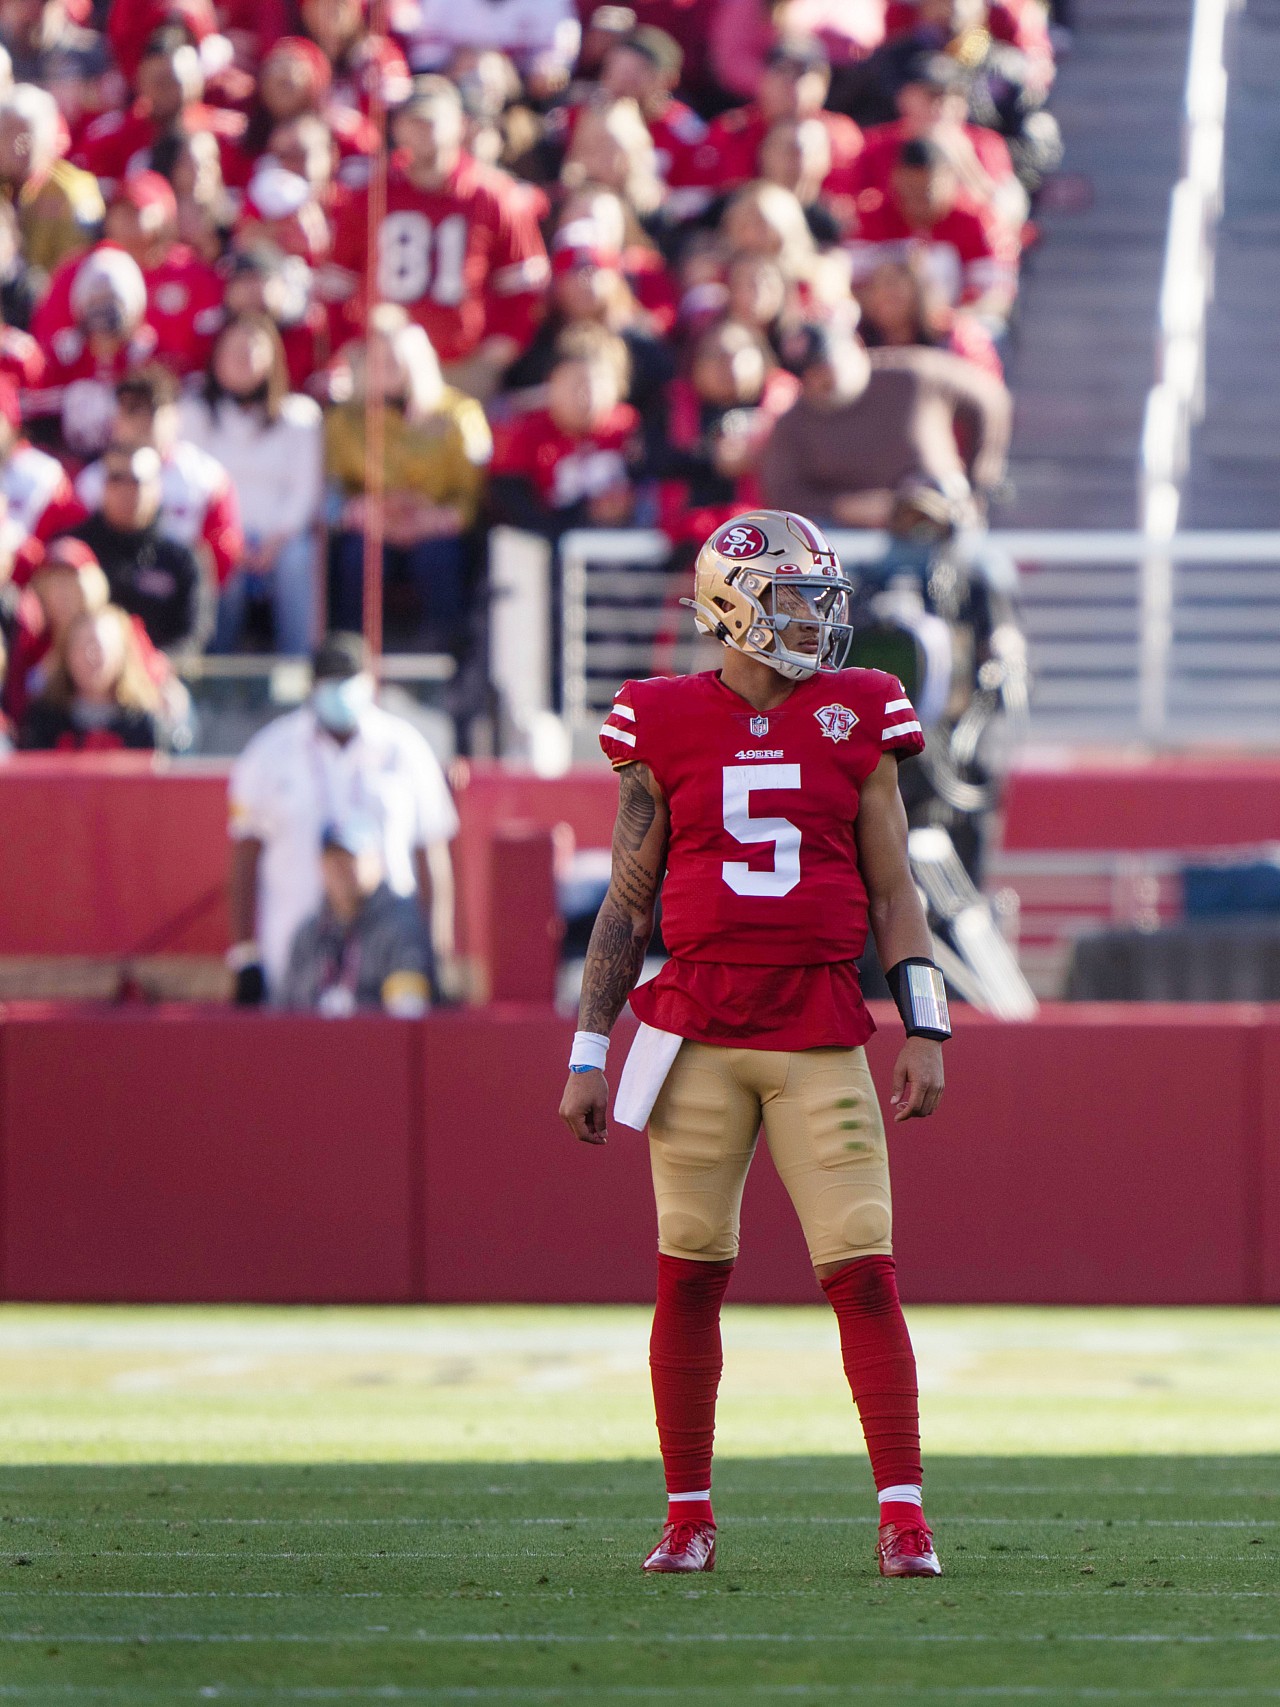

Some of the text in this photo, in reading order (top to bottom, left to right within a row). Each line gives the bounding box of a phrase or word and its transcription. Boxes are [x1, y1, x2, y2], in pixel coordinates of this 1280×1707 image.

[377, 209, 466, 305] 81
[723, 527, 756, 556] SF
[825, 711, 849, 731] 75
[735, 750, 784, 759] 49ERS
[722, 763, 801, 897] 5
